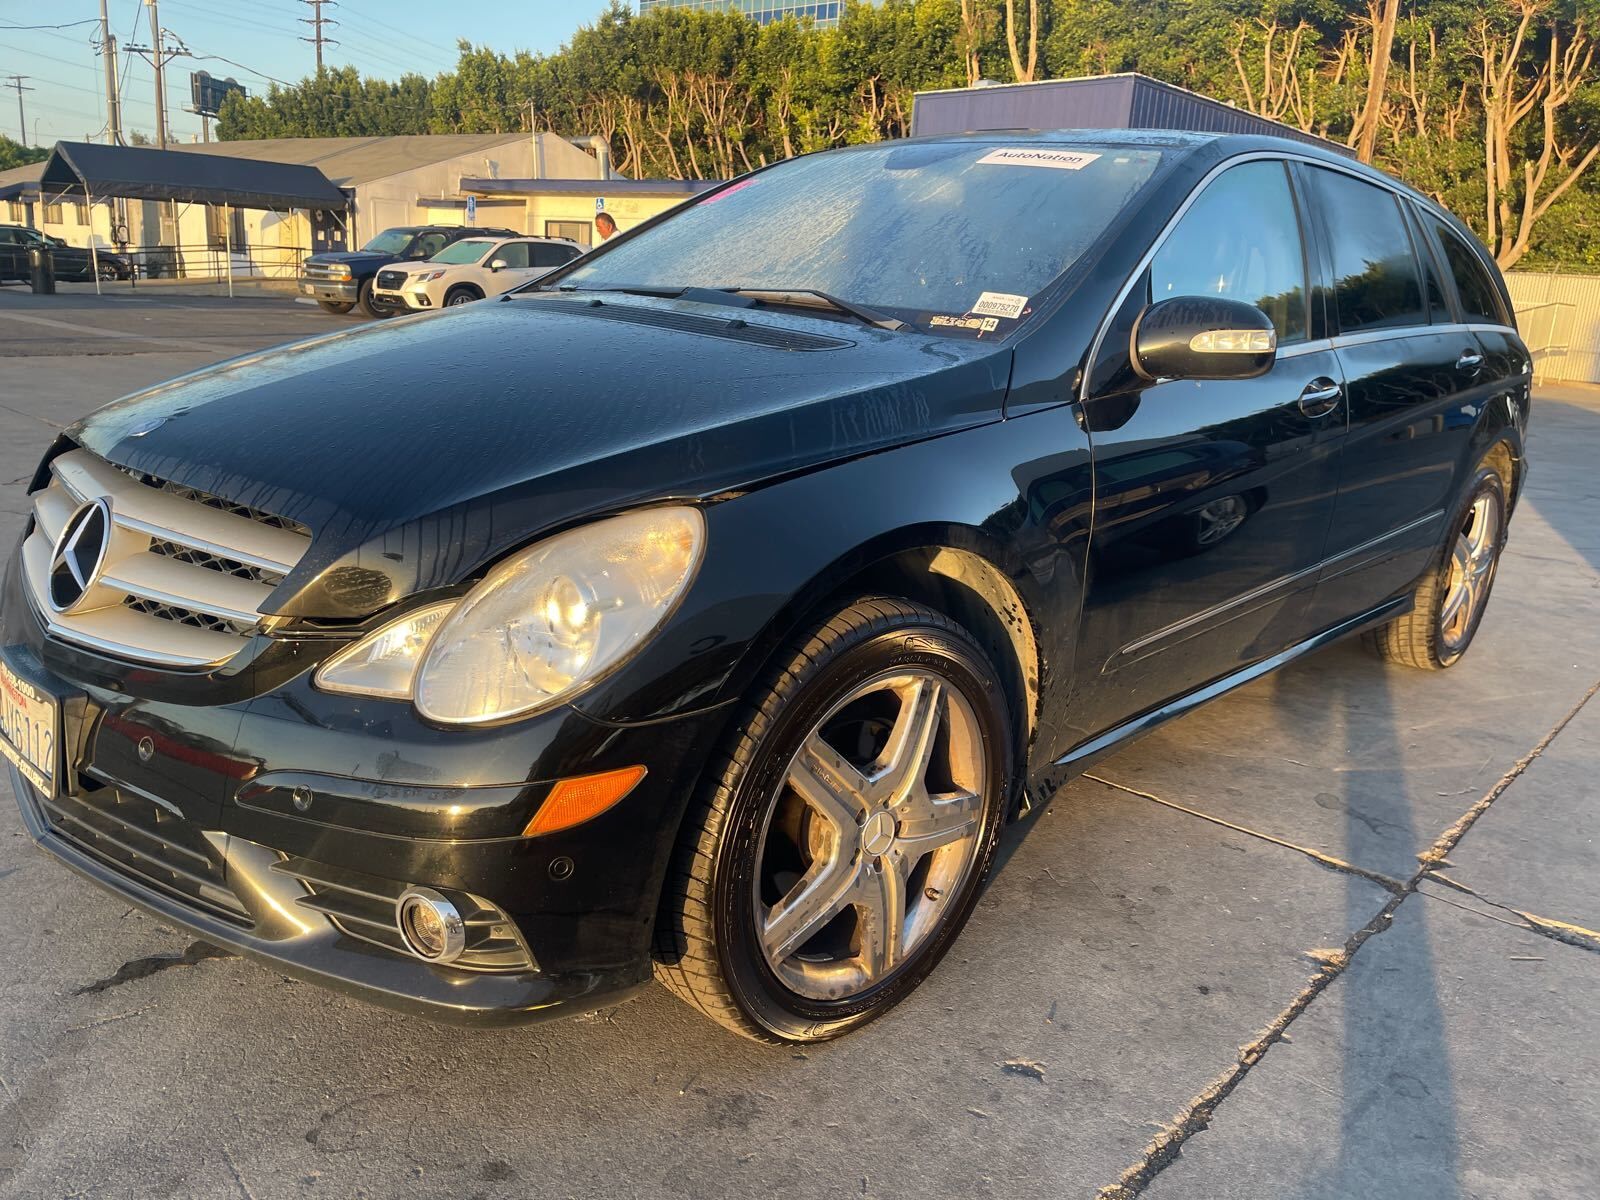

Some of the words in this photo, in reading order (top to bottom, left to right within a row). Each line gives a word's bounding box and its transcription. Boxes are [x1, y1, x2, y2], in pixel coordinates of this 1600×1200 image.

[995, 151, 1082, 162] AutoNation
[978, 301, 1020, 313] 000975270
[984, 320, 996, 329] 14
[0, 688, 53, 777] JY6112
